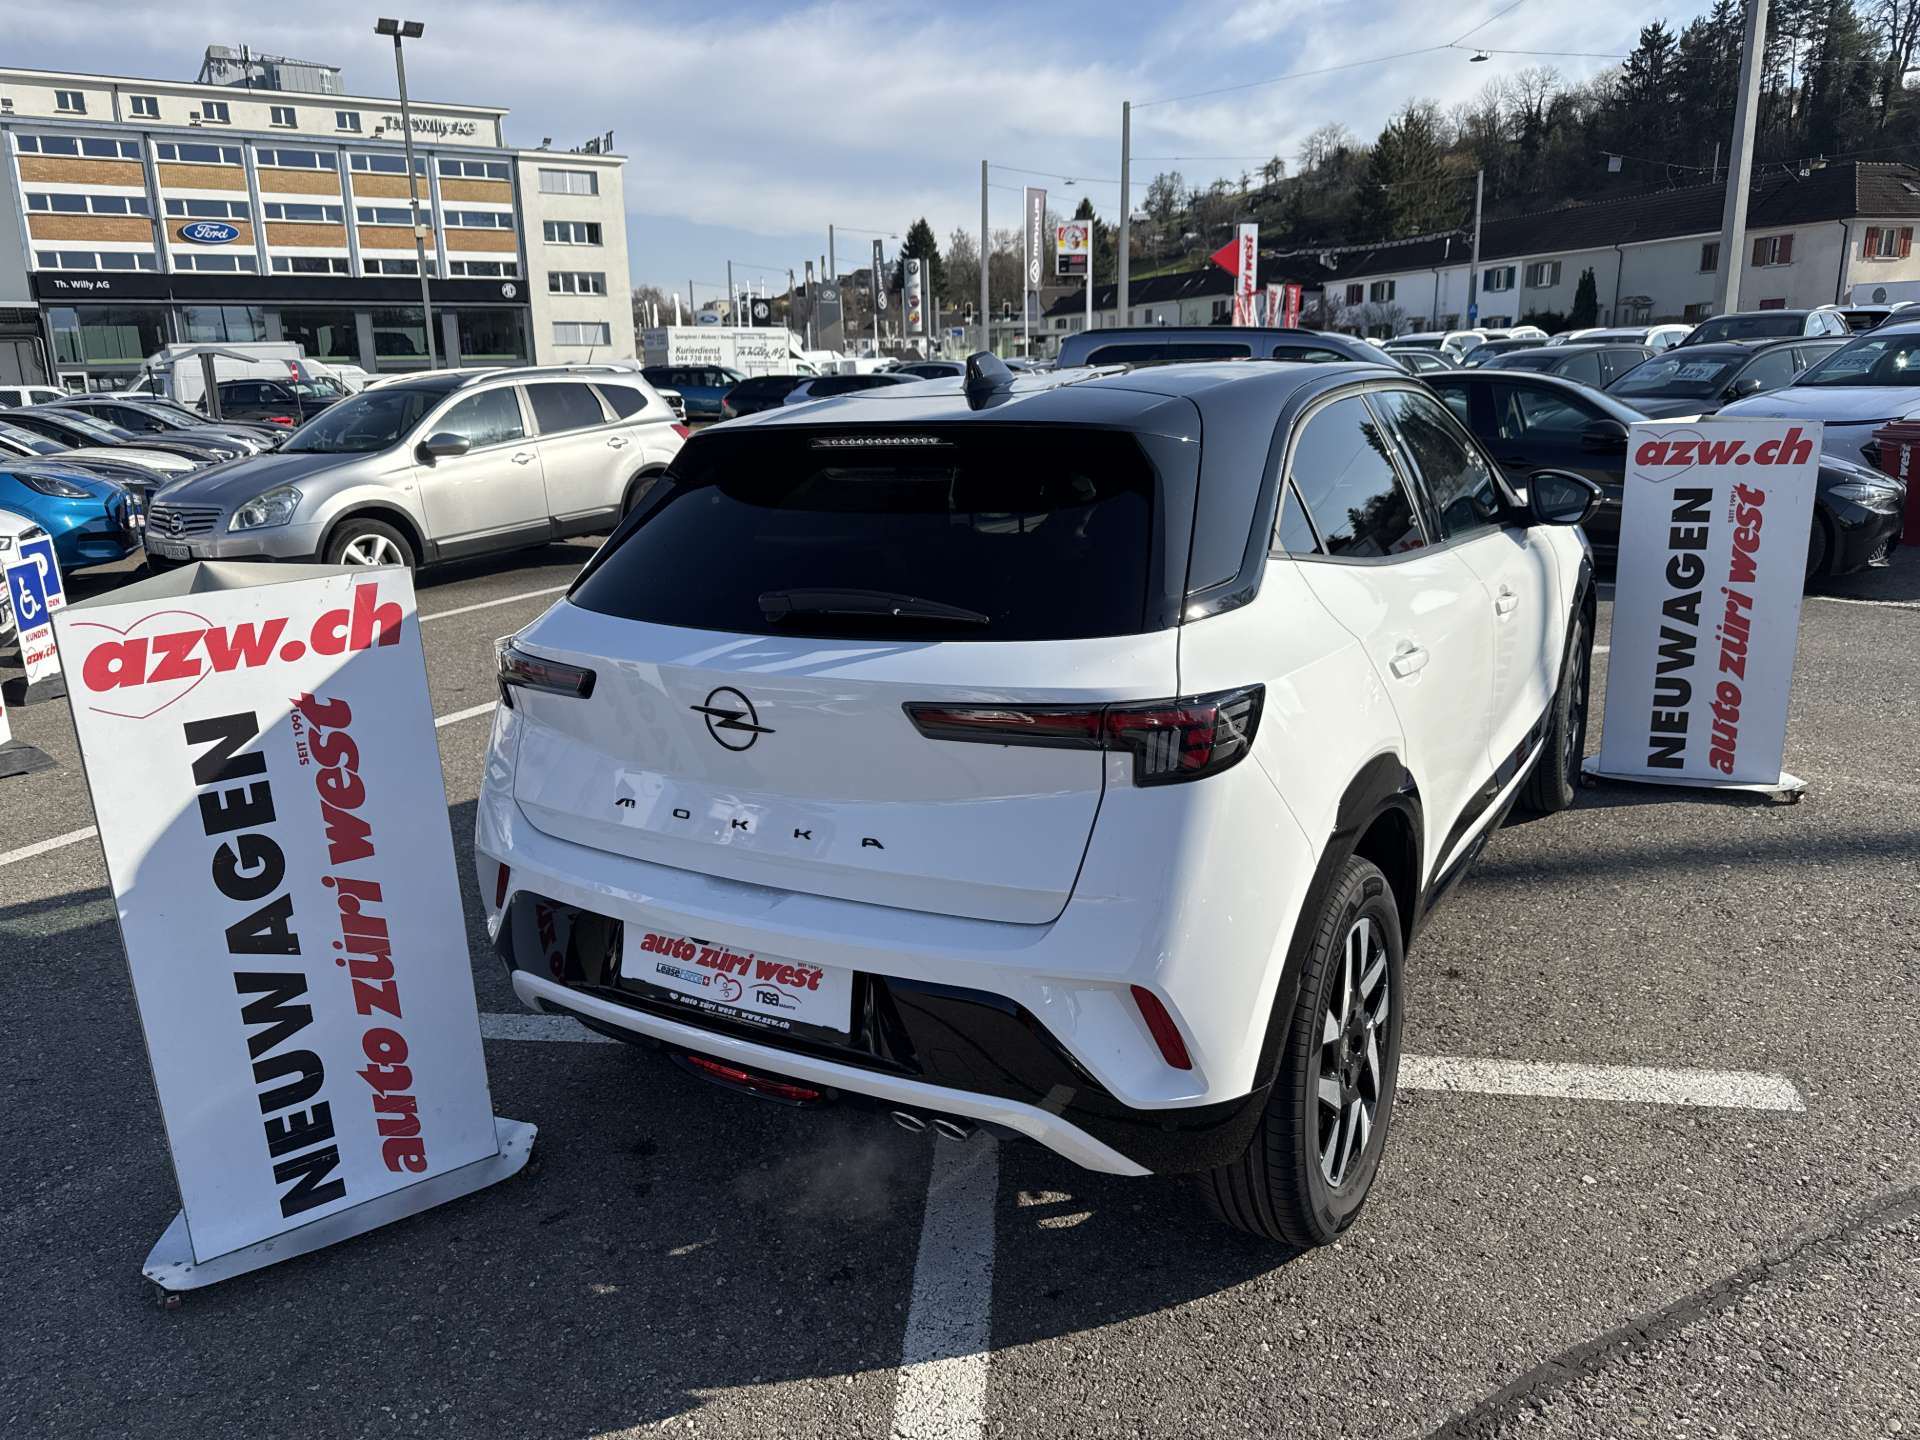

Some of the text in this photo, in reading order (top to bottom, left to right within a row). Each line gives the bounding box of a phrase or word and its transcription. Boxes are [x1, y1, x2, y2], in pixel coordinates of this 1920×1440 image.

[382, 115, 404, 131] Th
[1799, 169, 1810, 177] 48
[194, 224, 229, 240] Ford
[1244, 234, 1254, 271] west
[54, 279, 110, 291] Th. Willy AG
[675, 346, 721, 355] Kurierdienst
[1635, 428, 1813, 466] azw.ch
[1900, 443, 1911, 476] west
[48, 597, 61, 608] DEN
[25, 627, 49, 643] KUNDEN
[83, 583, 403, 693] azw.ch
[1647, 488, 1713, 769] NEUWAGEN
[1709, 483, 1765, 775] auto züri west
[26, 644, 58, 666] azw.ch
[290, 708, 309, 766] SEIT 1991
[615, 797, 885, 850] MOKKA
[288, 692, 428, 1174] auto züri west
[183, 711, 347, 1219] NEUWAGEN
[640, 933, 824, 991] auto züri west
[680, 996, 698, 1006] auto
[718, 1004, 737, 1016] west
[741, 1011, 790, 1030] www.azw.ch
[756, 990, 780, 1007] nsa
